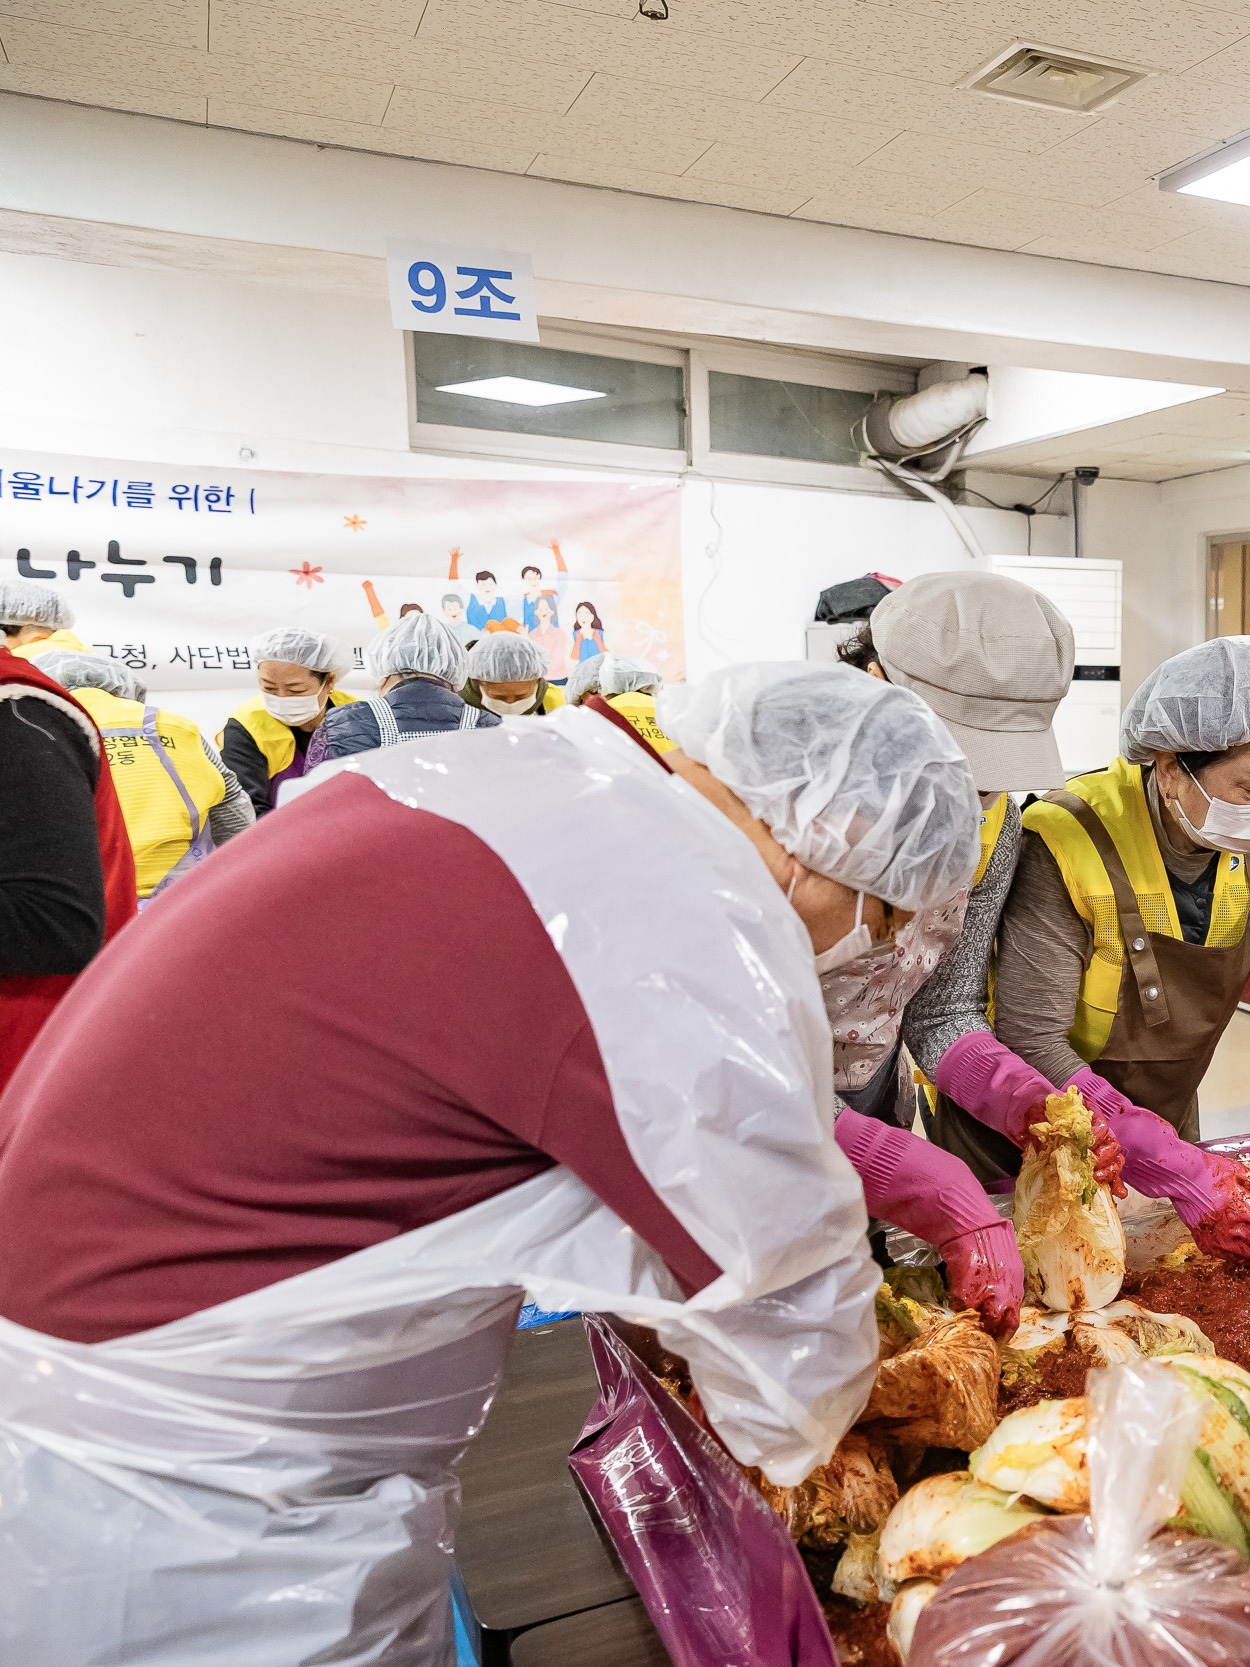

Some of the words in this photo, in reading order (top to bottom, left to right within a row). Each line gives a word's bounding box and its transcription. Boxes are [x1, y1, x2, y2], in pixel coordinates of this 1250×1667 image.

[407, 261, 521, 321] 9조
[0, 469, 156, 509] 울나기를
[168, 484, 235, 513] 위한
[17, 540, 222, 597] 나누기
[638, 728, 671, 740] 자양
